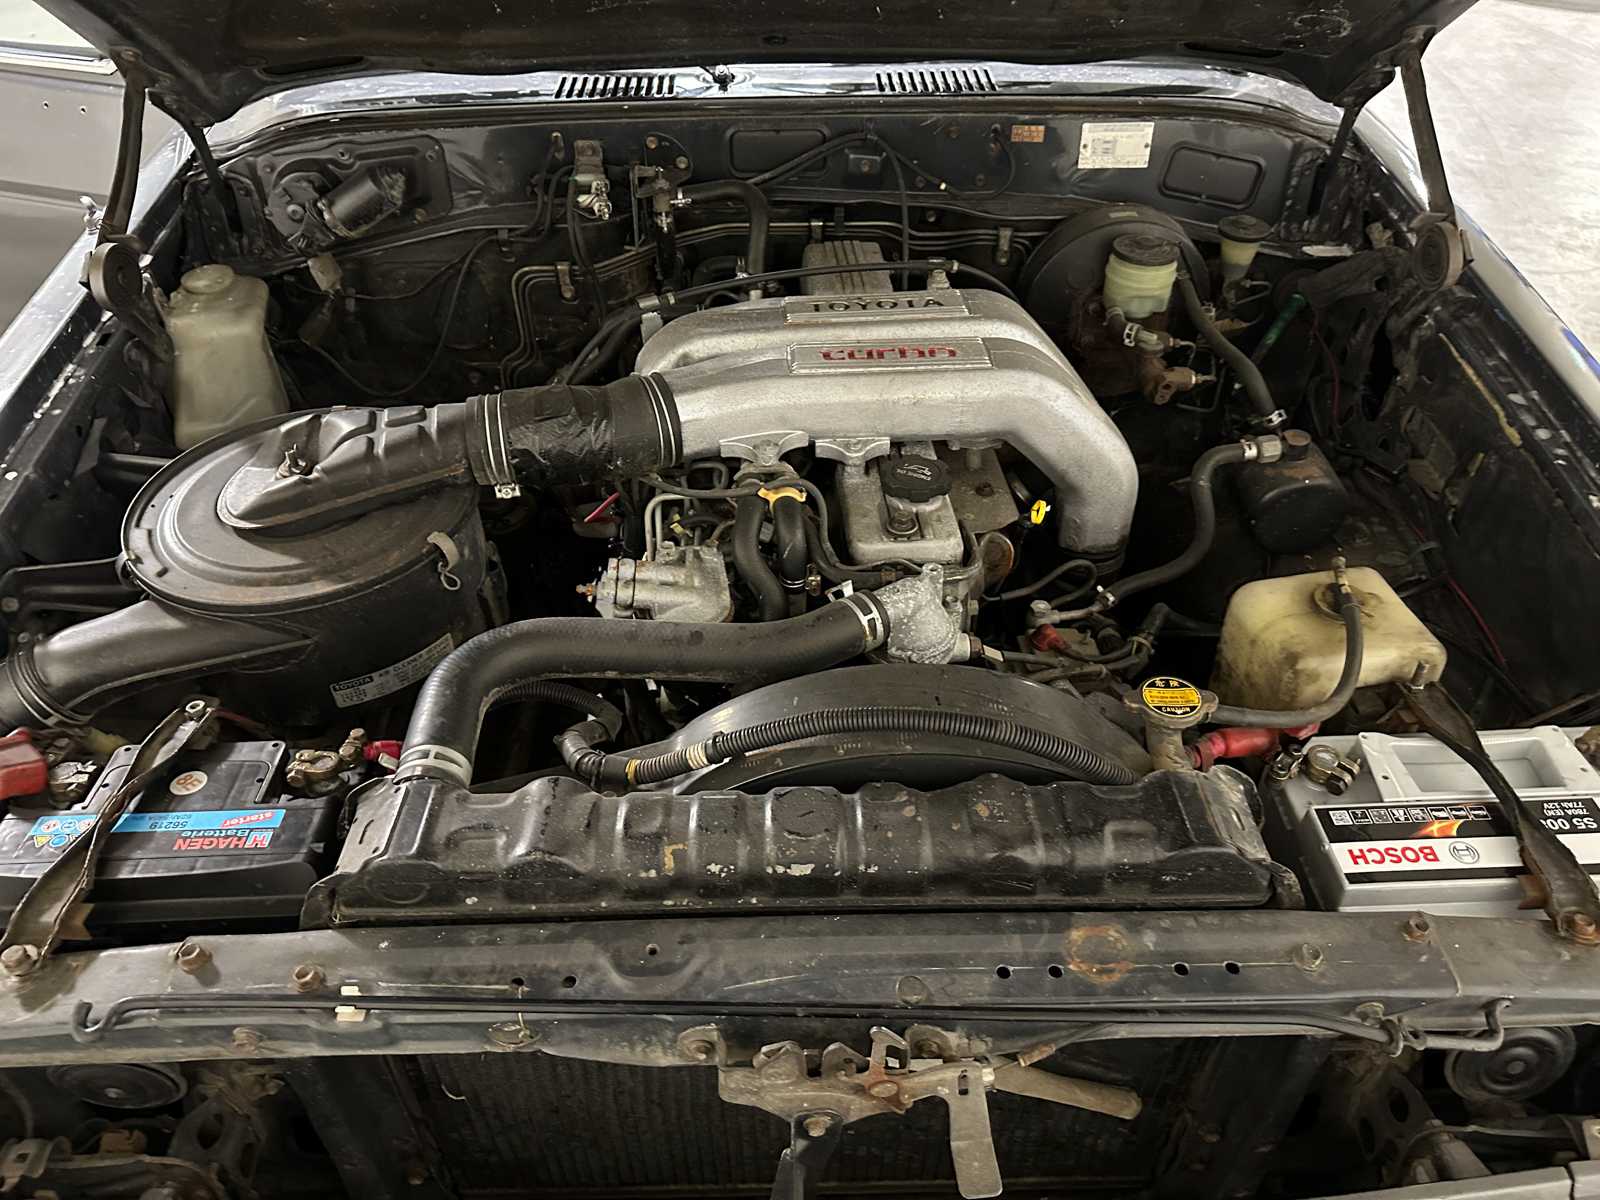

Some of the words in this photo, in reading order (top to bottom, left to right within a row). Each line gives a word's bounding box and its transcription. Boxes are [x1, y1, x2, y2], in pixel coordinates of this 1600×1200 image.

[810, 298, 945, 313] TOYOTA
[334, 677, 371, 690] TOYOTA
[1564, 808, 1590, 816] 780A
[223, 811, 273, 827] starter
[1572, 817, 1598, 829] S5
[181, 829, 251, 838] Batterie
[173, 836, 247, 850] HAGEN
[1347, 845, 1440, 866] BOSCH
